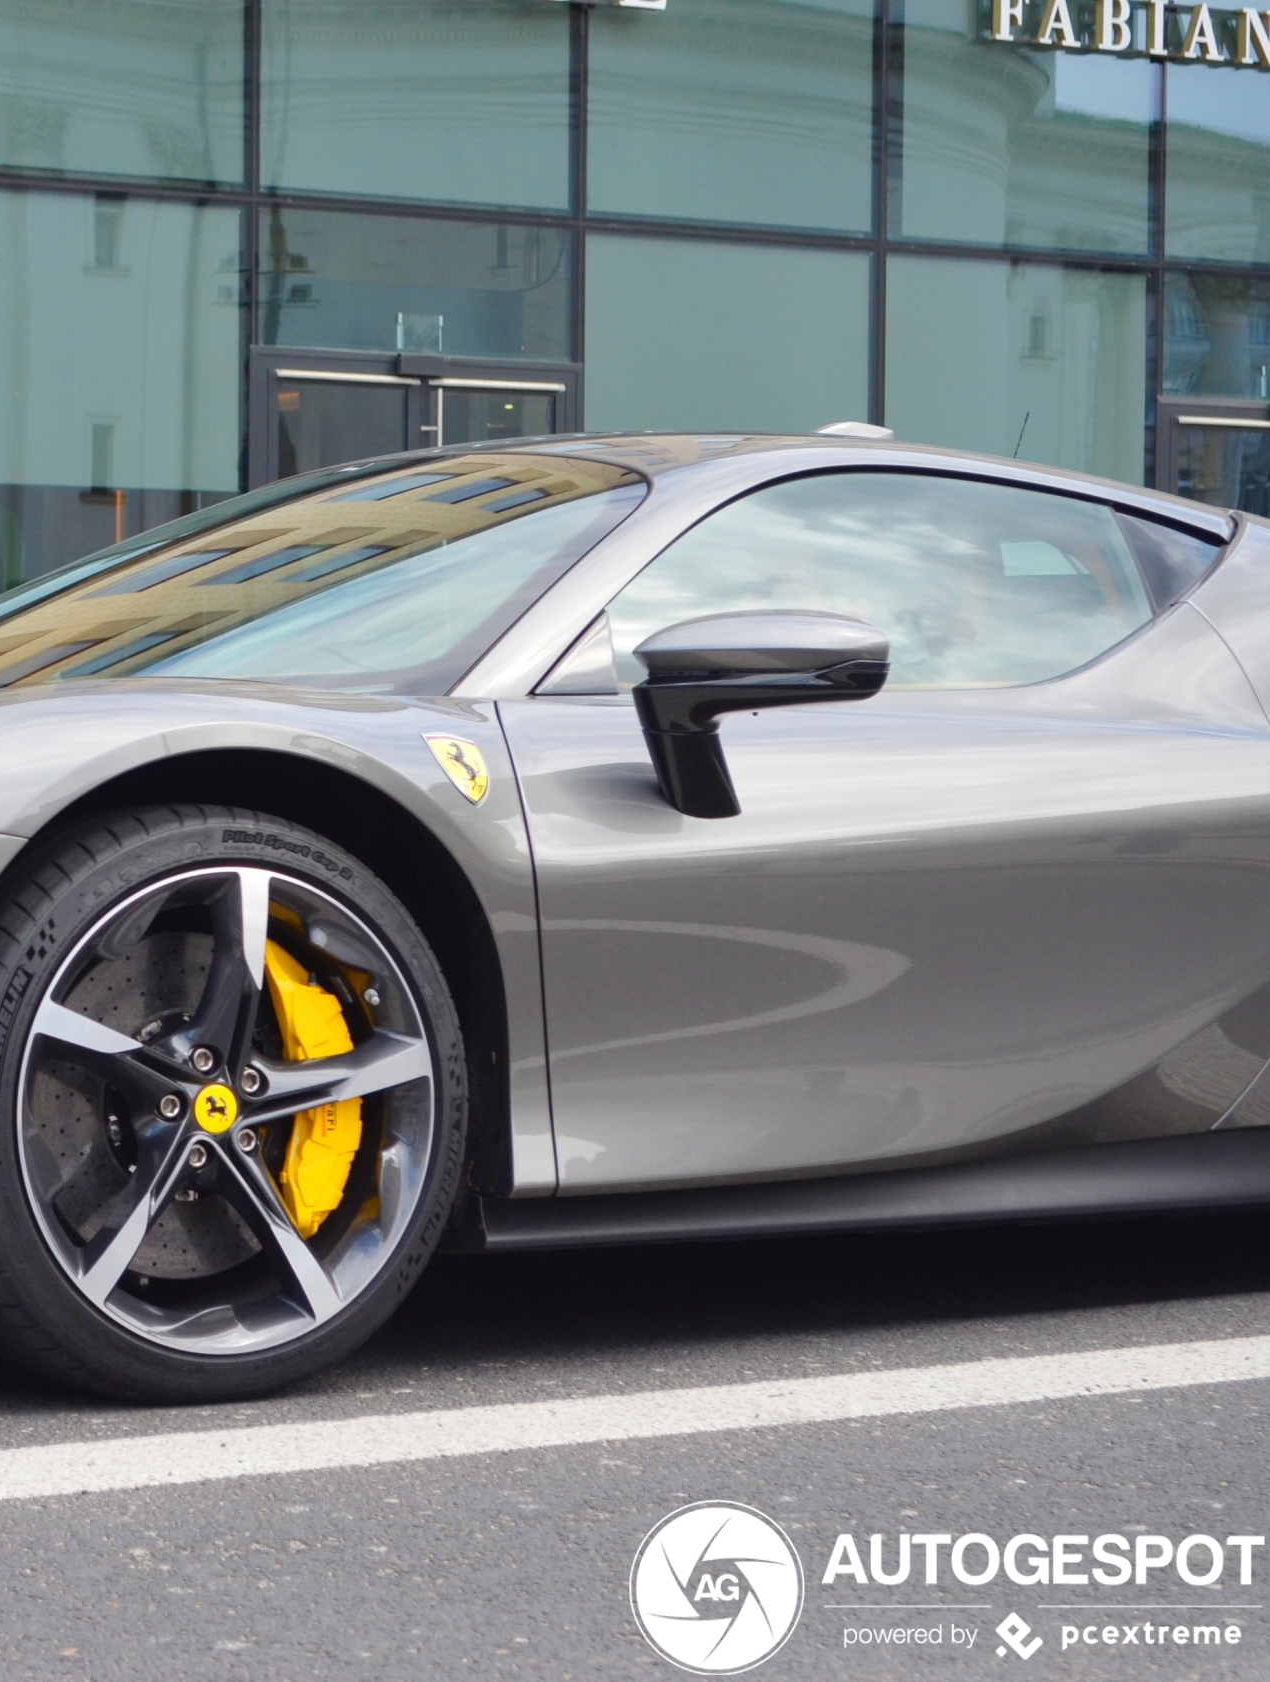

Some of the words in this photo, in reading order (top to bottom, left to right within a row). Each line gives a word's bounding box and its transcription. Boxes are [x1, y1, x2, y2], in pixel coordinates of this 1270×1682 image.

[222, 830, 264, 844] Pilot
[264, 833, 311, 858] Sport
[311, 851, 340, 872] Cup
[339, 866, 354, 881] 2
